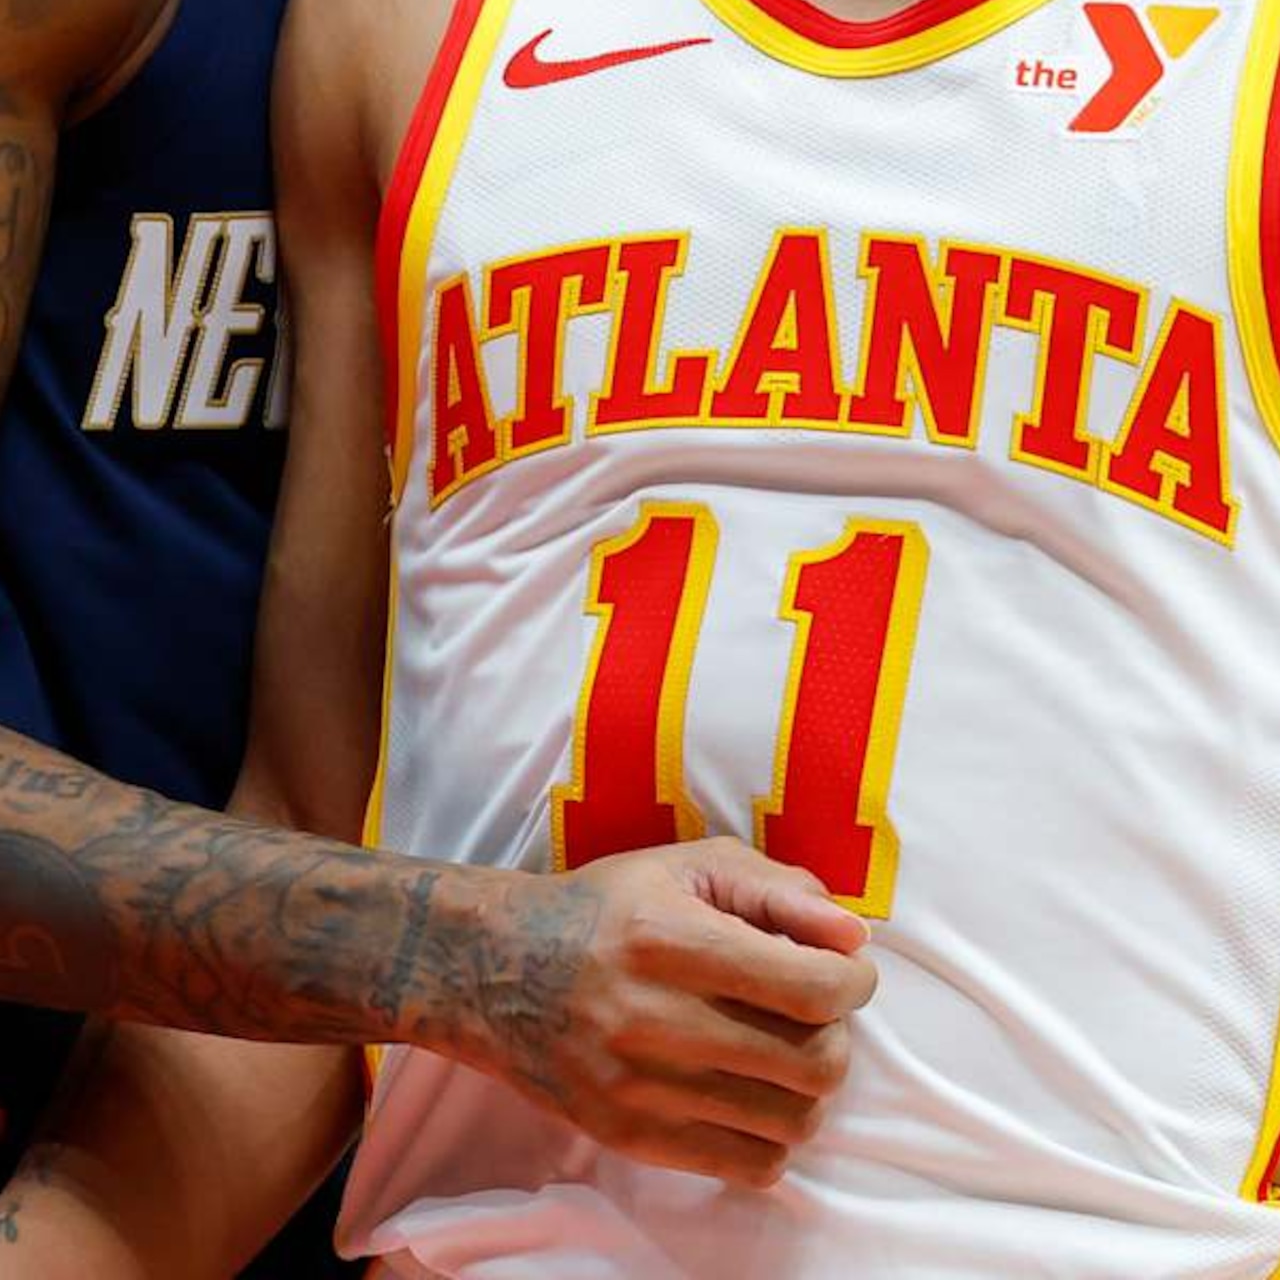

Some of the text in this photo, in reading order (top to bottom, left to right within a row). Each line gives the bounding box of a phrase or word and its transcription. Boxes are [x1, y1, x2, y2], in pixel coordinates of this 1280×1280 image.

[1015, 60, 1077, 90] the
[81, 210, 291, 431] NE
[428, 227, 1240, 550] ATLANTA
[549, 500, 931, 920] 11
